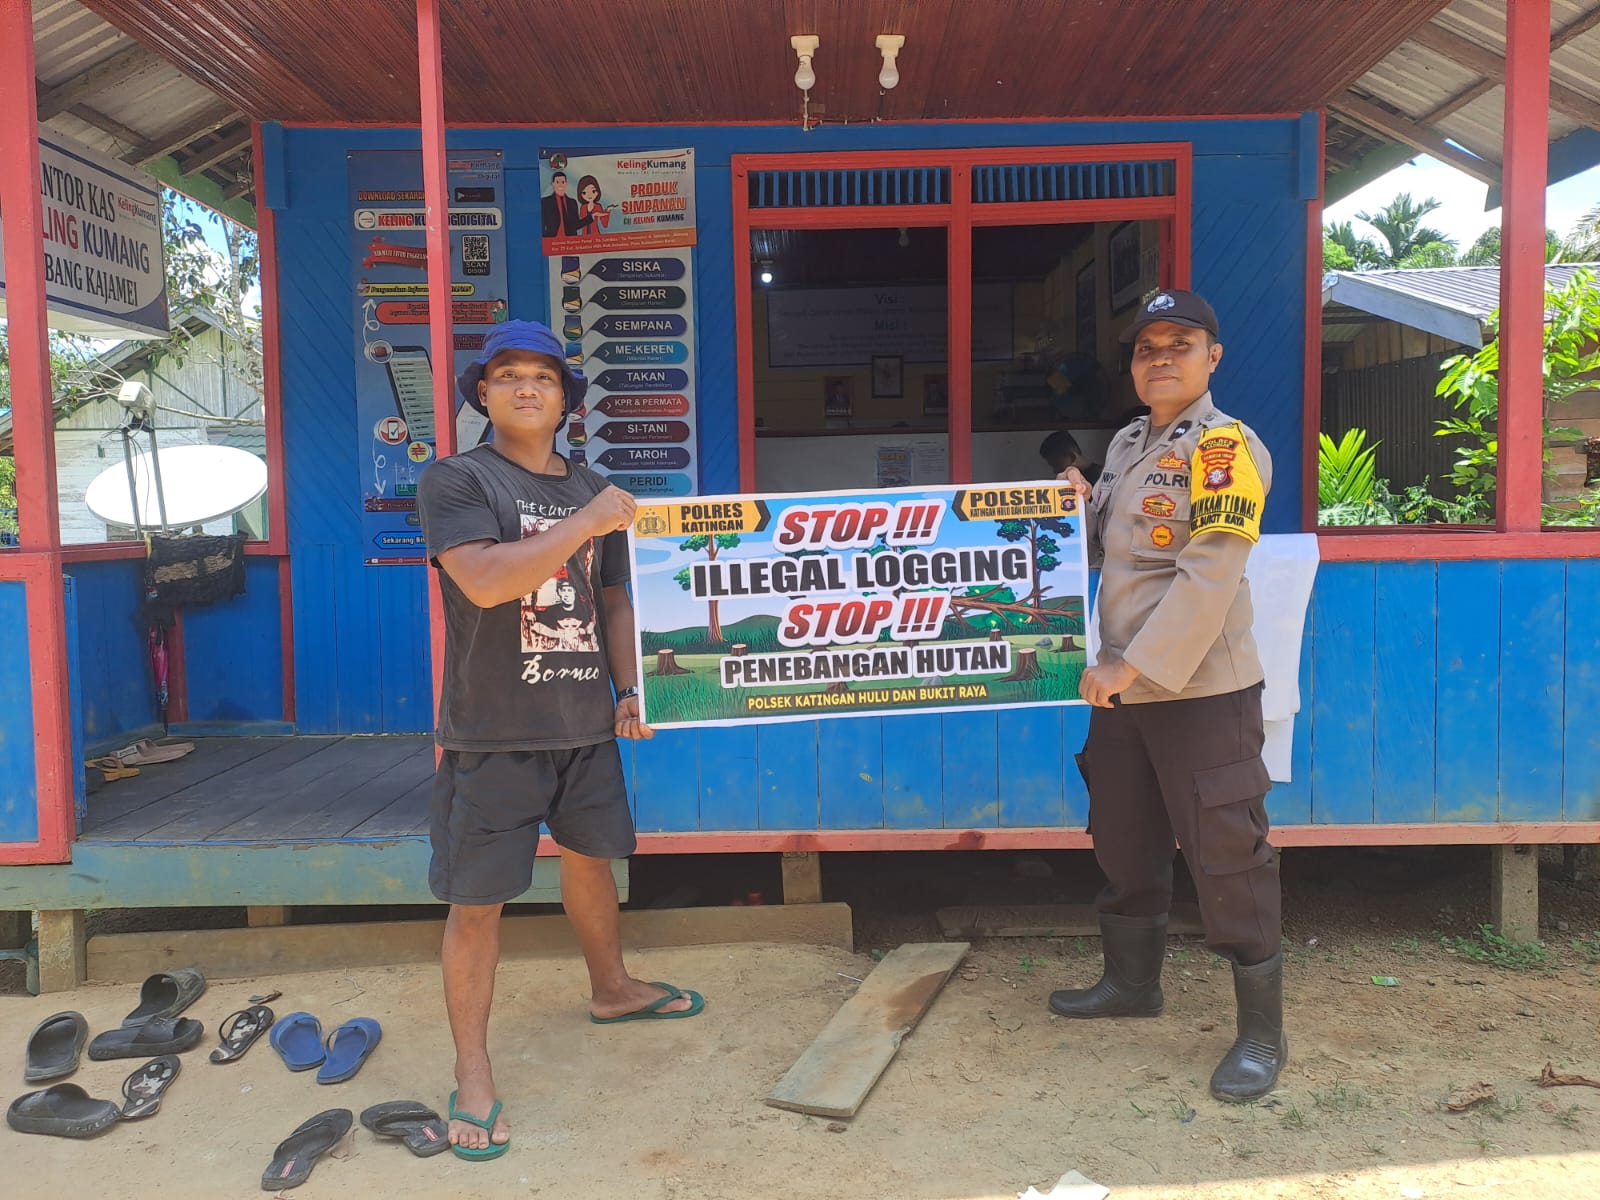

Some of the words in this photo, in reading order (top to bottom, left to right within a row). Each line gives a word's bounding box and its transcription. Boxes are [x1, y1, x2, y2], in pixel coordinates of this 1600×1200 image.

[41, 162, 87, 212] NTOR
[87, 182, 116, 223] KAS
[630, 181, 678, 198] PRODUK
[621, 197, 687, 215] SIMPANAN
[378, 215, 414, 227] KELING
[42, 206, 79, 250] LING
[82, 220, 150, 274] KUMANG
[622, 261, 662, 272] SISKA
[44, 252, 83, 291] BANG
[85, 265, 138, 307] KAJAMEI
[618, 289, 667, 300] SIMPAR
[615, 320, 673, 331] SEMPANA
[615, 344, 674, 355] ME-KEREN
[625, 372, 666, 382] TAKAN
[614, 398, 632, 406] KPR
[634, 398, 641, 406] &
[642, 398, 682, 406] PERMATA
[627, 423, 668, 434] SI-TANI
[628, 449, 668, 460] TAROH
[629, 476, 667, 487] PERIDI
[1144, 473, 1189, 488] POLRI
[969, 488, 1051, 508] POLSEK
[515, 499, 537, 513] THE
[680, 502, 744, 521] POLRES
[681, 519, 744, 534] KATINGAN
[779, 504, 889, 546] STOP
[892, 504, 940, 540] !!!
[382, 536, 414, 545] Sekarang
[693, 556, 847, 598] ILLEGAL
[855, 548, 1028, 589] LOGGING
[783, 599, 893, 641] STOP
[896, 596, 945, 634] !!!
[521, 654, 600, 685] Borneo
[724, 650, 908, 685] PENEBANGAN
[915, 646, 1008, 675] HUTAN
[748, 696, 791, 710] POLSEK
[795, 692, 855, 708] KATINGAN
[858, 689, 891, 704] HULU
[893, 687, 917, 701] DAN
[919, 686, 956, 700] BUKIT
[958, 684, 988, 698] RAYA
